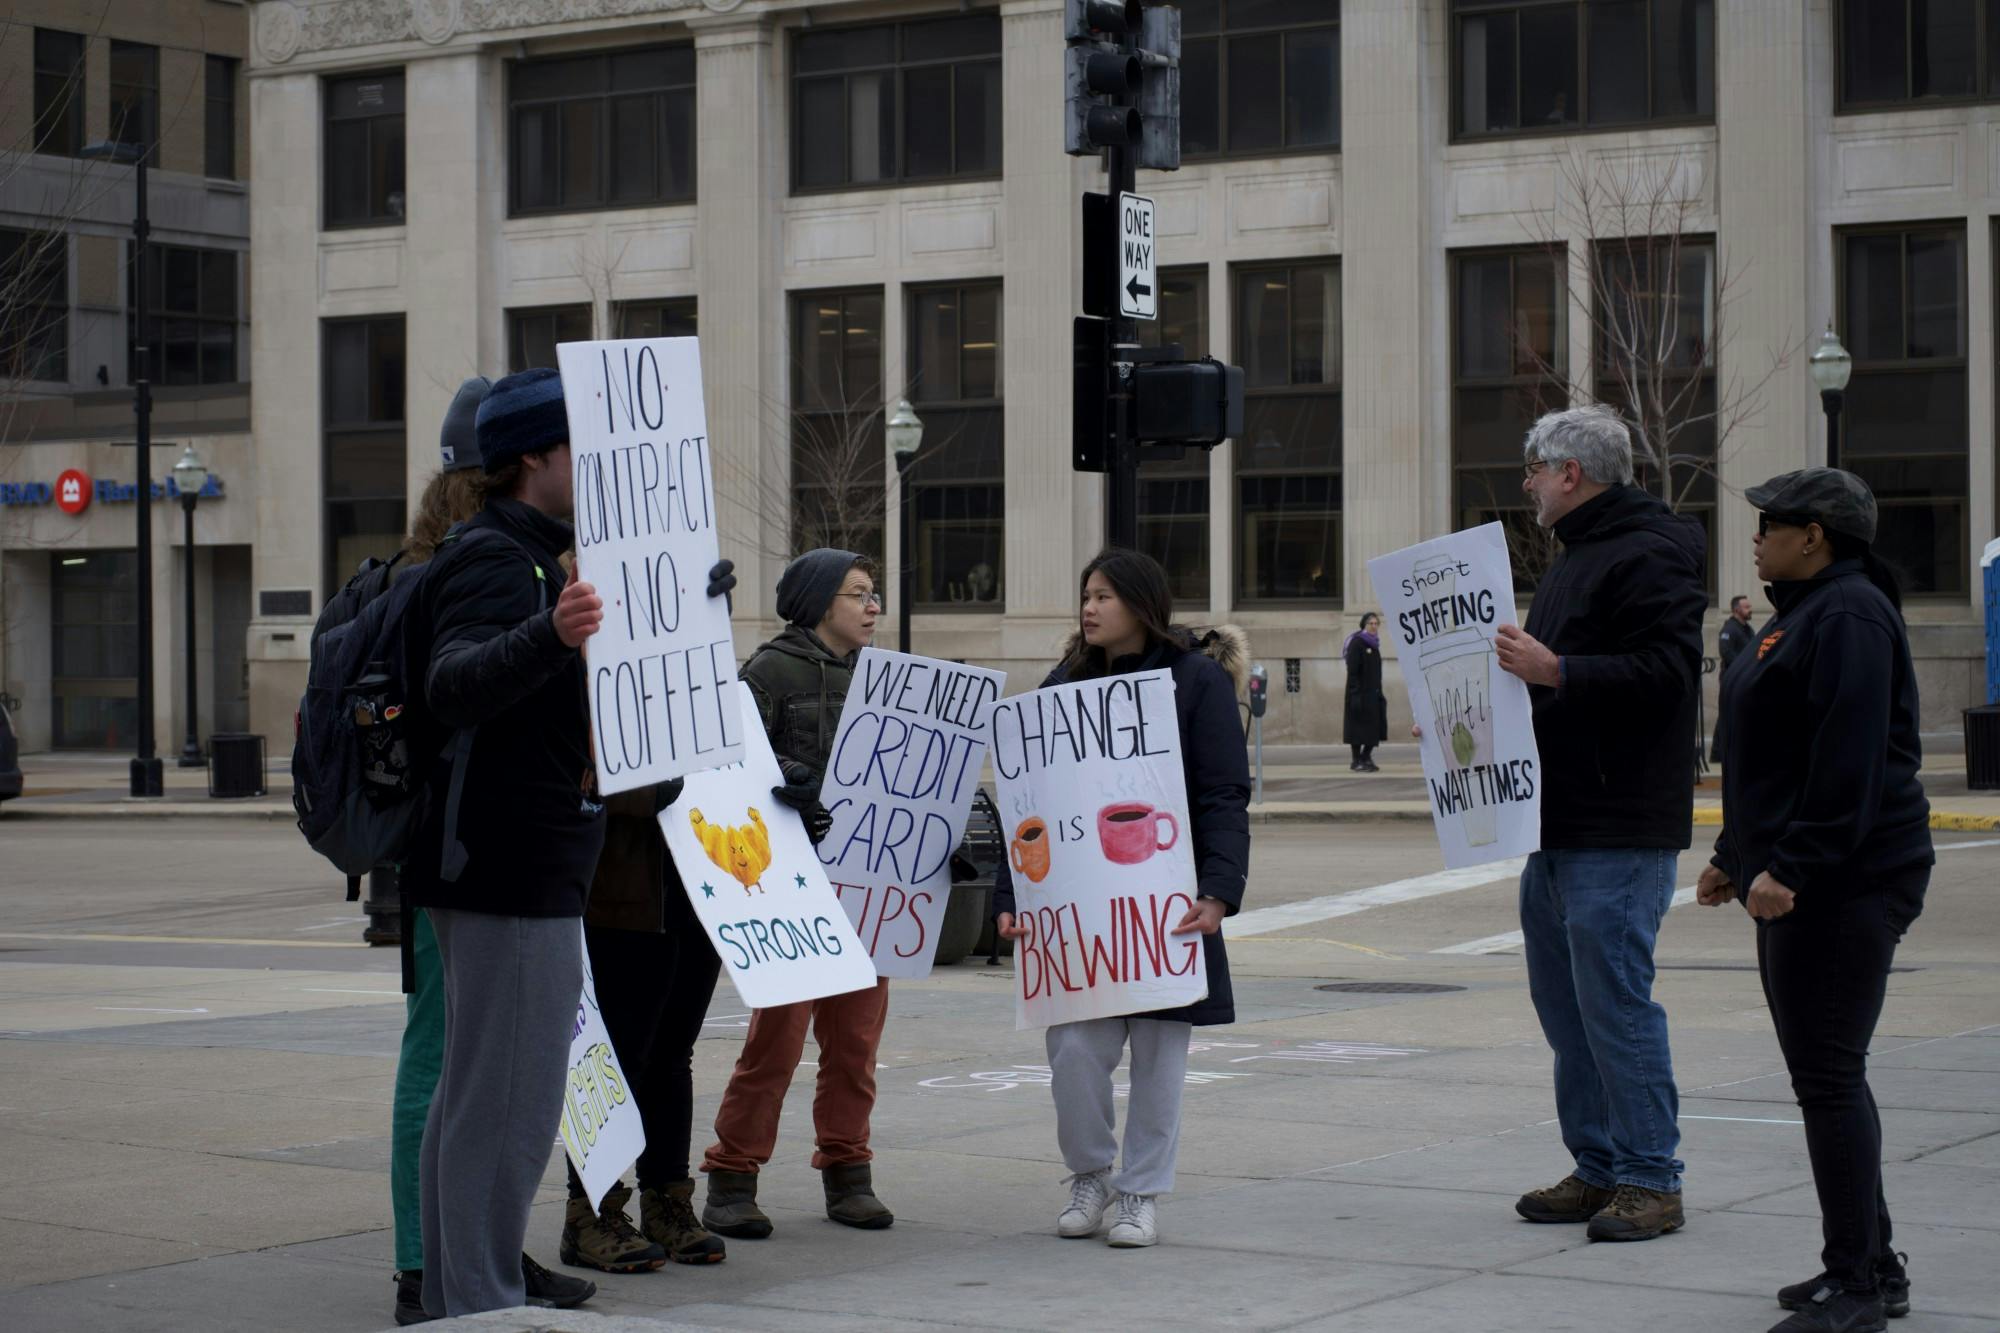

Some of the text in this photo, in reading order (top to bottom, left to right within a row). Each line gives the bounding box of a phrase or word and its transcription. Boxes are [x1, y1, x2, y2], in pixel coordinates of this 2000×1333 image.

[1125, 206, 1150, 238] ONE
[1125, 240, 1151, 271] WAY
[577, 436, 709, 548] CONTRACT
[1400, 589, 1495, 645] STAFFING
[596, 639, 742, 775] COFFEE
[864, 659, 997, 730] WE NEED
[833, 712, 985, 804] CREDIT
[992, 677, 1170, 780] CHANGE
[1431, 759, 1535, 818] WAIT TIMES
[1058, 815, 1085, 842] IS
[718, 916, 842, 970] STRONG
[1019, 893, 1198, 1000] BREWING
